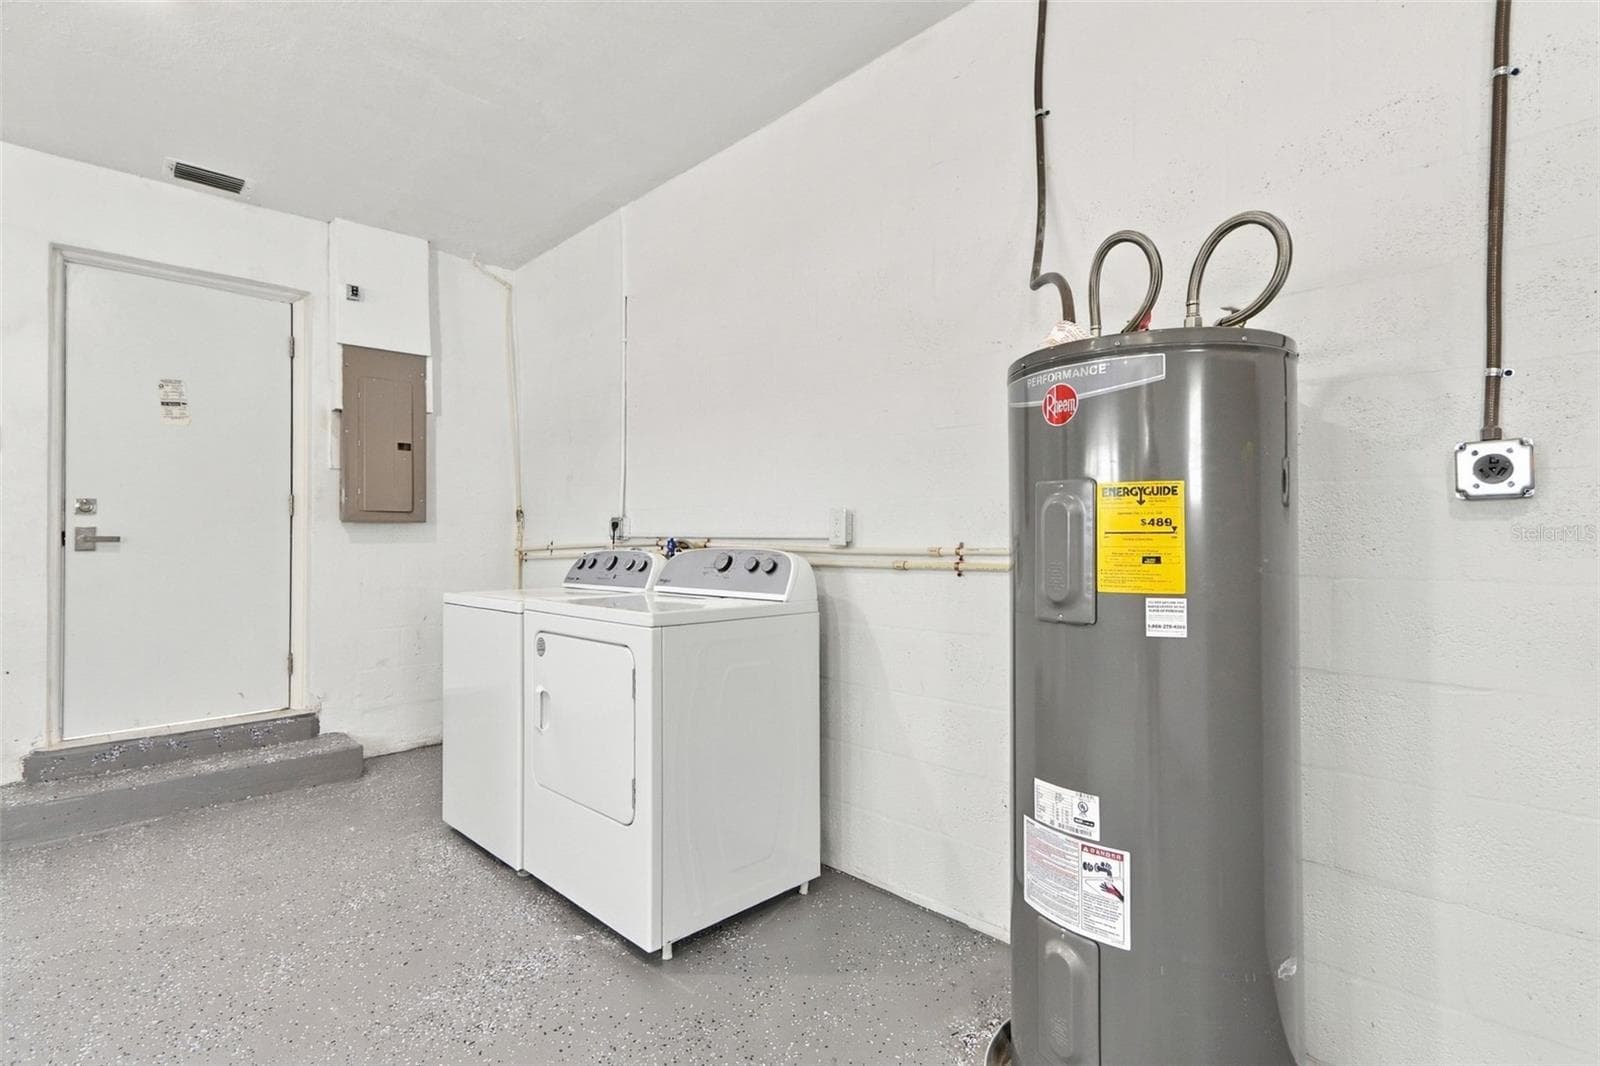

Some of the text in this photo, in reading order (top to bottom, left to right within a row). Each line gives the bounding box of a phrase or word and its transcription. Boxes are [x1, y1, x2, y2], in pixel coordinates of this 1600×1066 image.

[1027, 364, 1107, 389] PERFORMANCE
[1046, 386, 1076, 418] Rheem
[1102, 486, 1179, 497] ENERGYGUIDE
[1140, 518, 1173, 527] $489
